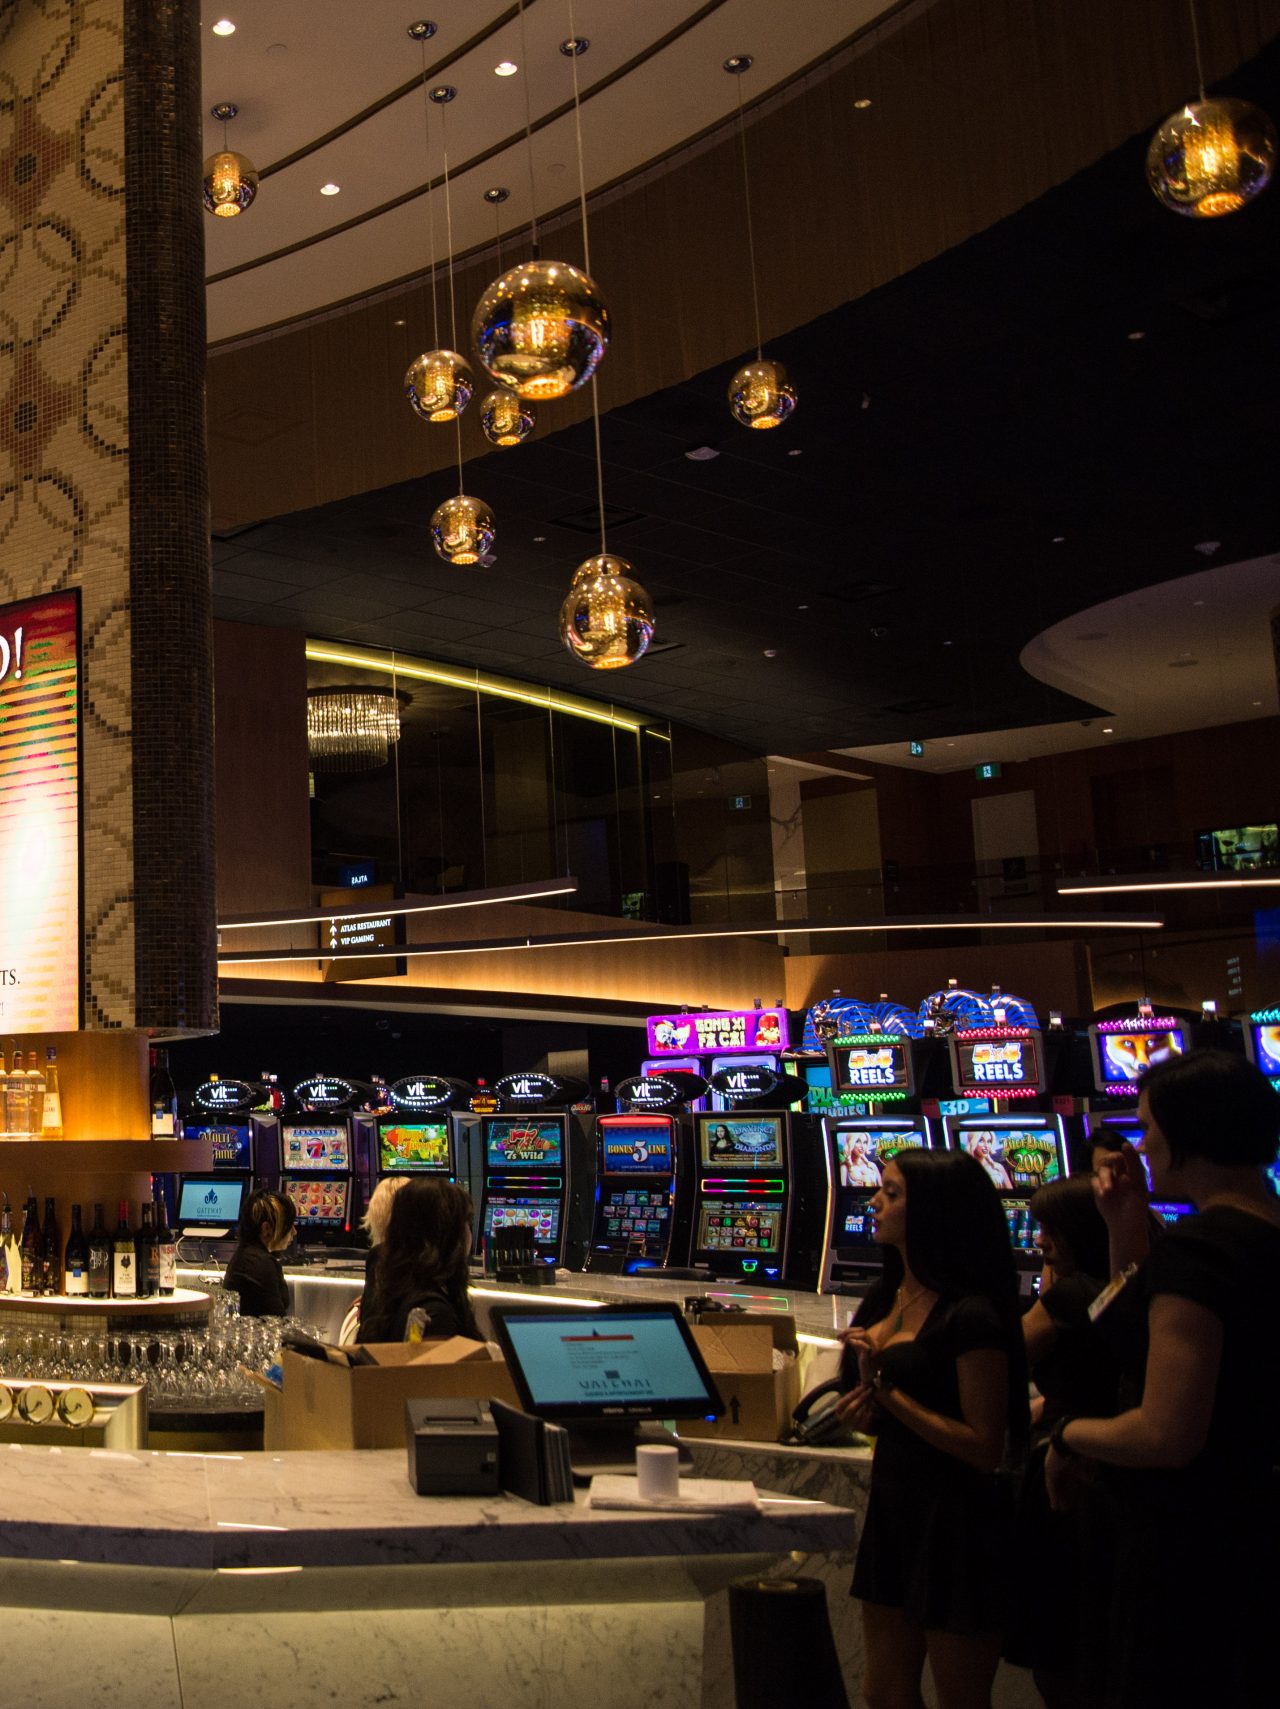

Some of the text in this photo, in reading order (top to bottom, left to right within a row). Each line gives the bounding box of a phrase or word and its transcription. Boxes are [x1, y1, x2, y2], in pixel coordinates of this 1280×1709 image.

[340, 919, 391, 933] ATLAS RESTAURANT
[341, 934, 374, 945] VIP GAMING
[695, 1017, 745, 1032] GONG XI
[698, 1031, 745, 1047] FA CAI
[849, 1068, 895, 1084] REELS
[974, 1063, 1024, 1080] REELS
[942, 1101, 970, 1115] 3D
[202, 1132, 230, 1142] MULTI
[608, 1141, 667, 1162] BONUS 5 LINE
[734, 1143, 776, 1152] DIAMONDS
[504, 1150, 544, 1160] 7s Wild
[1014, 1153, 1045, 1173] 200
[845, 1224, 863, 1232] REELS
